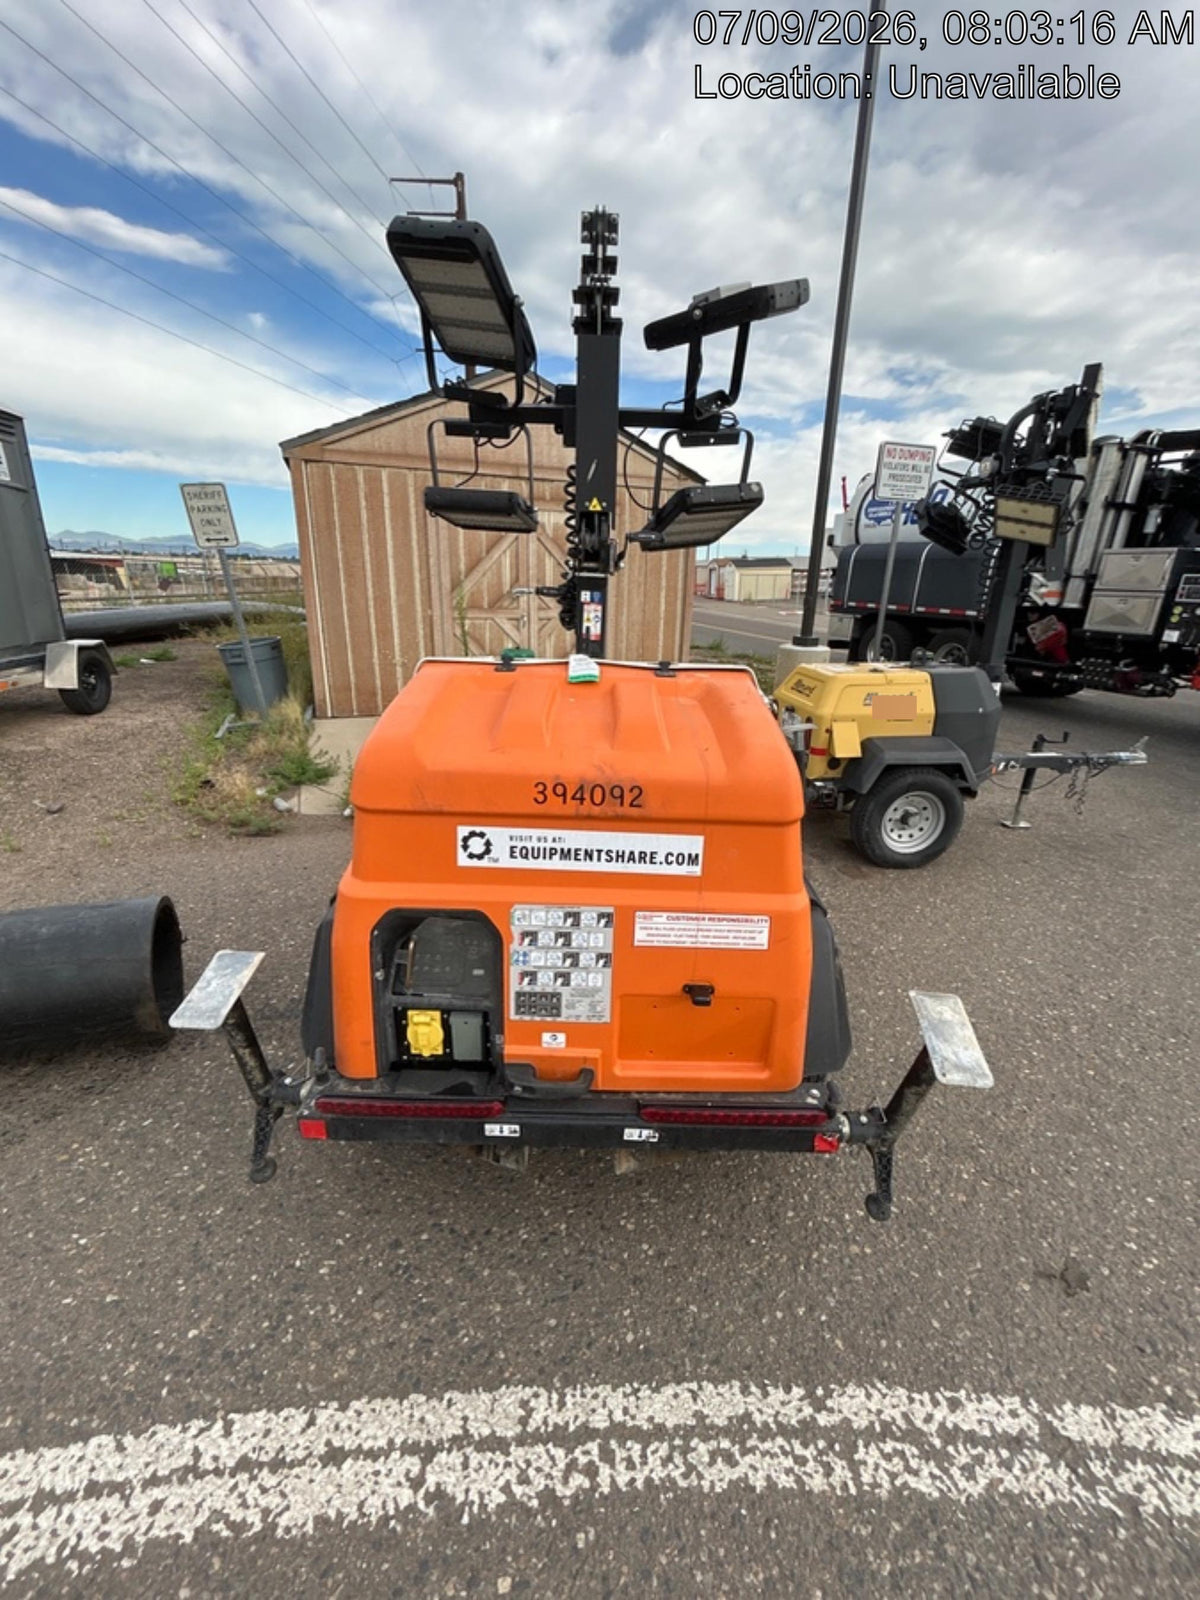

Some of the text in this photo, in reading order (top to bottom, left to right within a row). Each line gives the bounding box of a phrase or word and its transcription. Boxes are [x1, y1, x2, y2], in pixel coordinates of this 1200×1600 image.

[886, 447, 932, 462] NO DUMPING
[883, 461, 910, 472] VIOLATORS
[187, 491, 222, 500] SHERIFF
[189, 504, 227, 513] PARKING
[201, 518, 221, 527] ONLY
[533, 782, 644, 808] 394092
[508, 834, 533, 844] VISIT
[536, 835, 548, 844] US
[509, 845, 700, 867] EQUIPMENTSHARE.COM
[707, 916, 769, 924] RESPONSIBILITY
